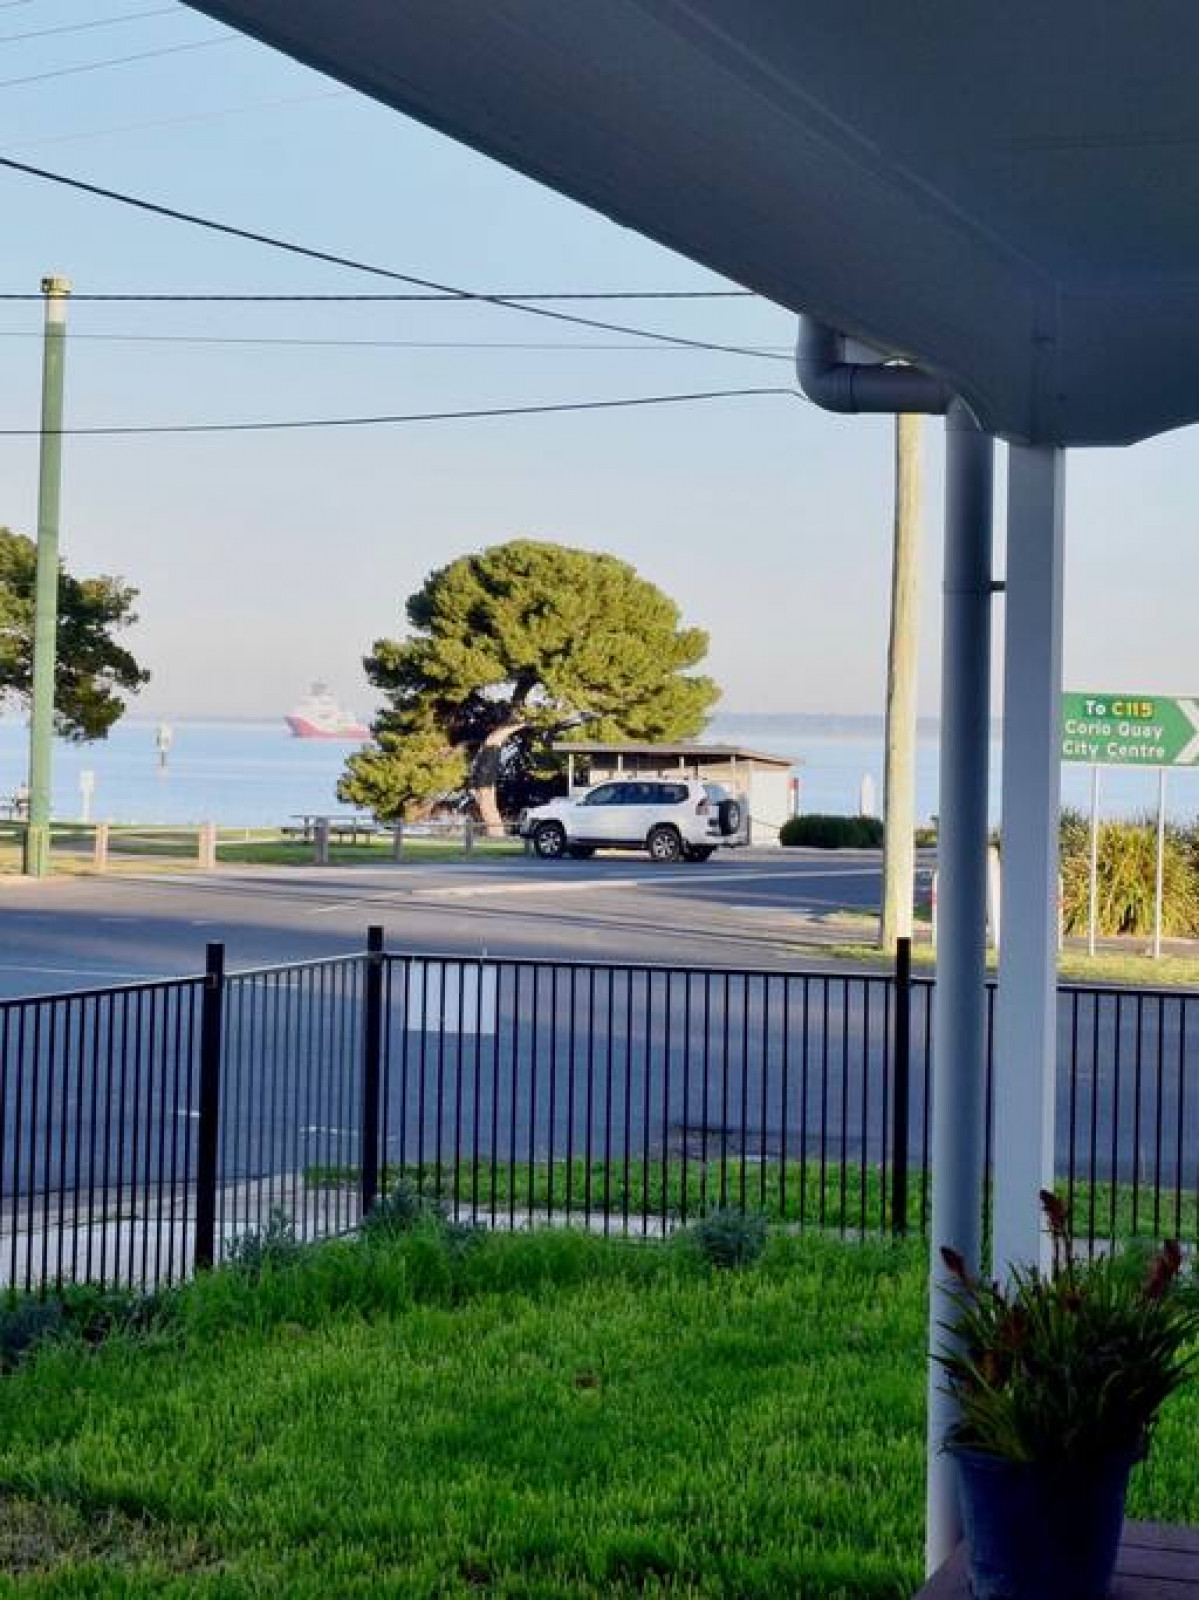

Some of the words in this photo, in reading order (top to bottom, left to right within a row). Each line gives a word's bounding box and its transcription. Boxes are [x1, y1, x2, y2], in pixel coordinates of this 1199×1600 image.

[1086, 700, 1106, 715] To
[1111, 702, 1153, 717] C115
[1065, 719, 1111, 734] Corio
[1118, 721, 1163, 741] Quay
[1063, 740, 1098, 759] City
[1107, 742, 1165, 758] Centre
